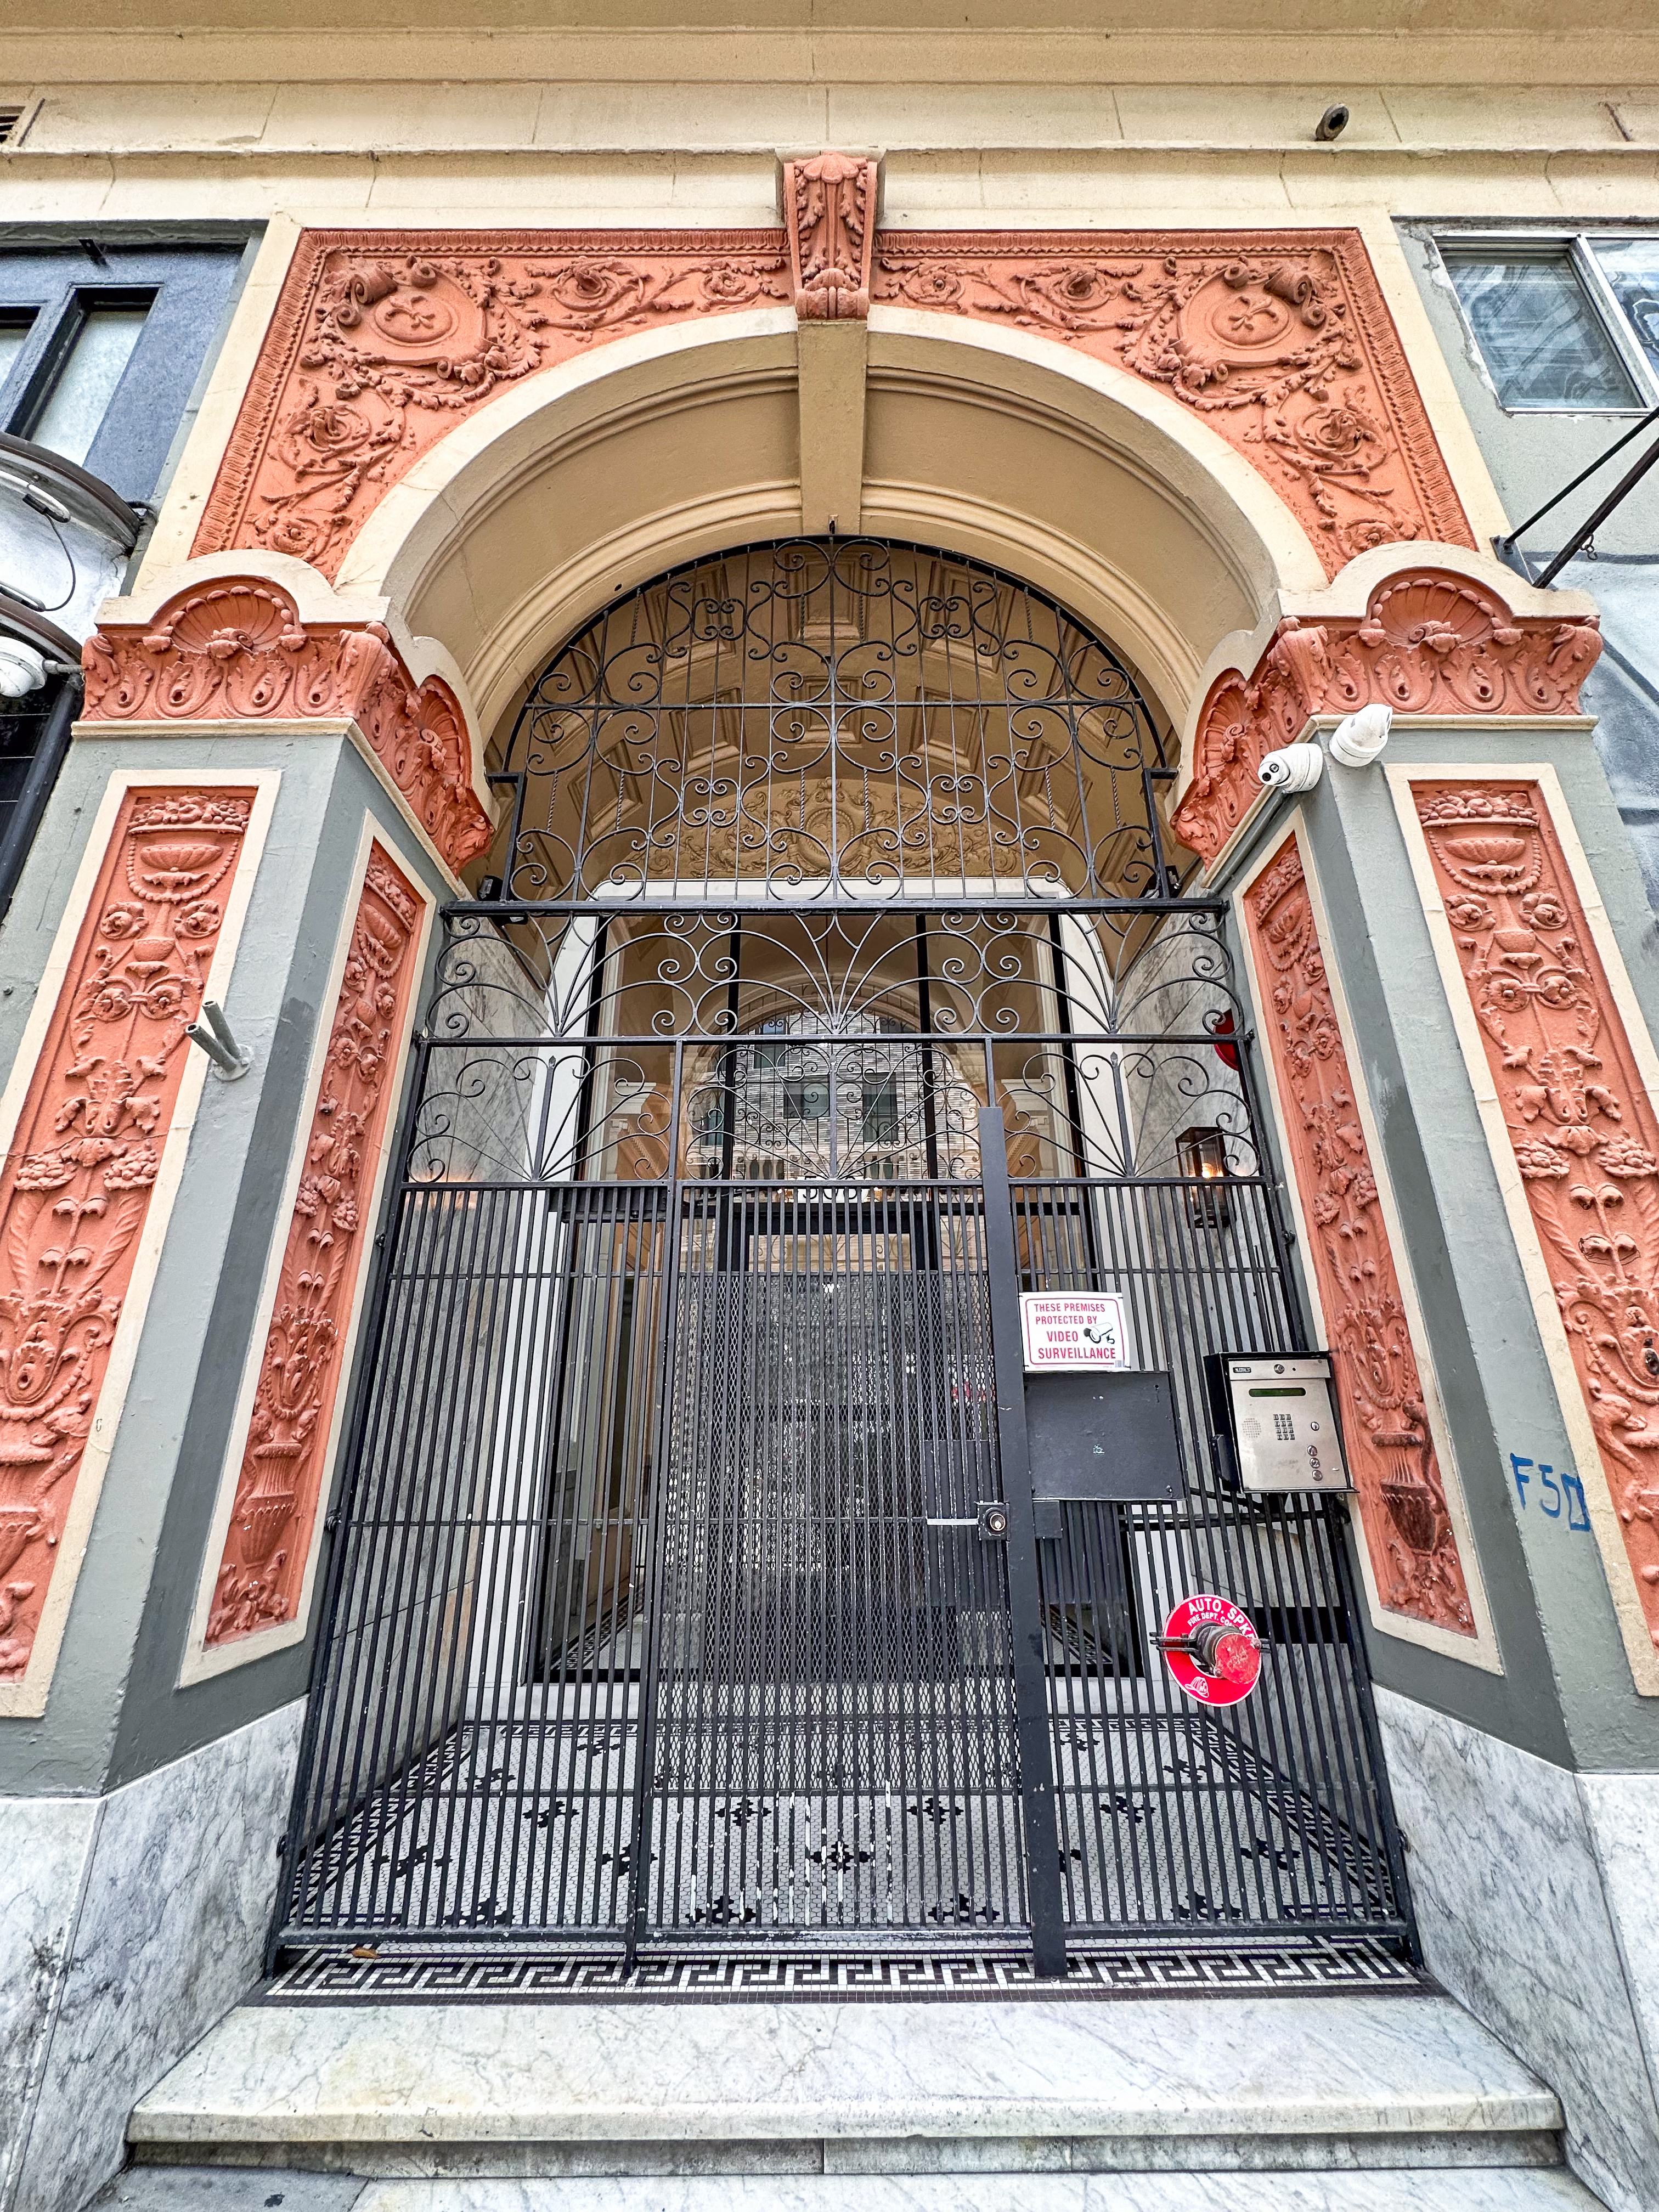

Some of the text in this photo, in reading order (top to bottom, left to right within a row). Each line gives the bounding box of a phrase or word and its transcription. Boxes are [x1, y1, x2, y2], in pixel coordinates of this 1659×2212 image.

[1034, 1303, 1105, 1312] THESE PREMISES
[1035, 1316, 1097, 1324] PROTECTED BY
[1046, 1331, 1078, 1342] VIDEO
[1038, 1347, 1116, 1359] SURVEILLANCE
[1188, 1598, 1224, 1616] AUTO.
[1187, 1613, 1201, 1627] FIRE
[1201, 1612, 1219, 1621] DEPT.
